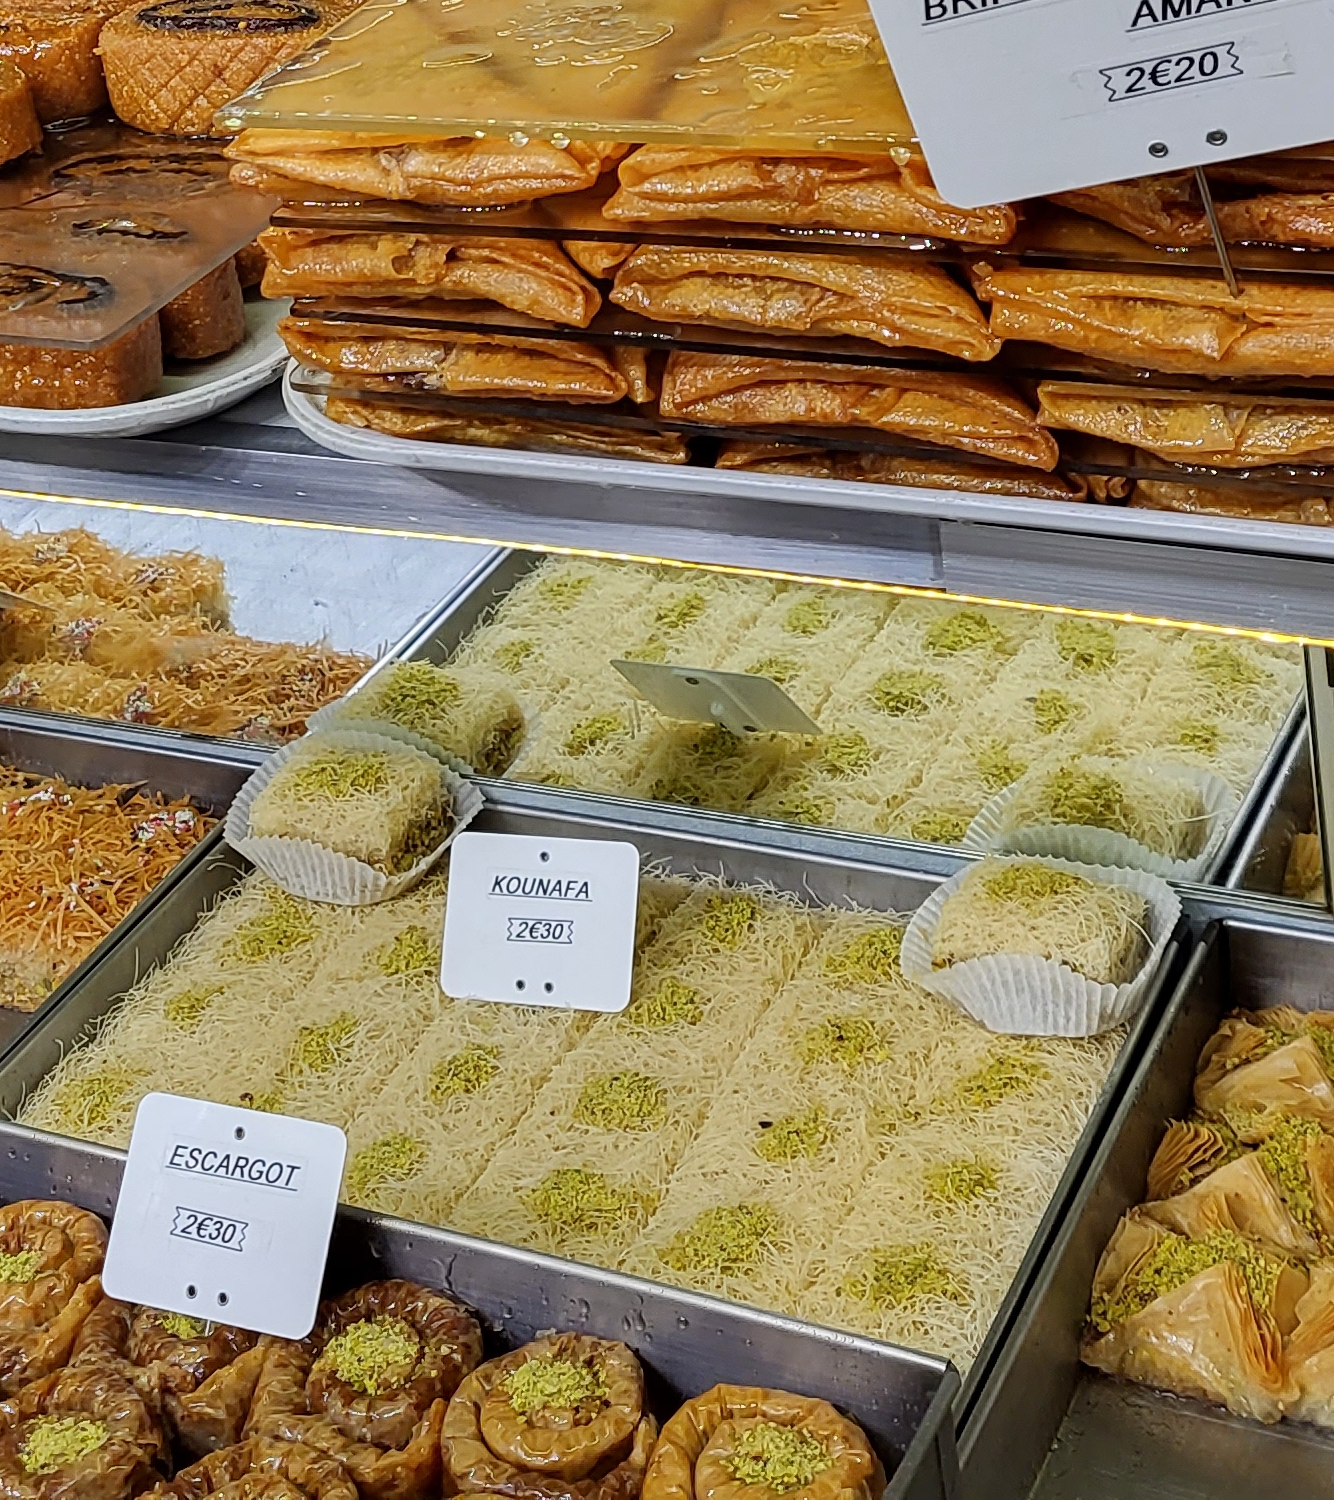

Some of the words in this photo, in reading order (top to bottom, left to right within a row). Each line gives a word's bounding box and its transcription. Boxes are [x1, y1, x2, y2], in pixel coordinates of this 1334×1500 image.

[1124, 50, 1219, 95] 2€20
[491, 875, 590, 899] KOUNAFA
[515, 921, 564, 940] 2€30
[168, 1144, 302, 1187] ESCARGOT
[180, 1214, 237, 1244] 2€30
